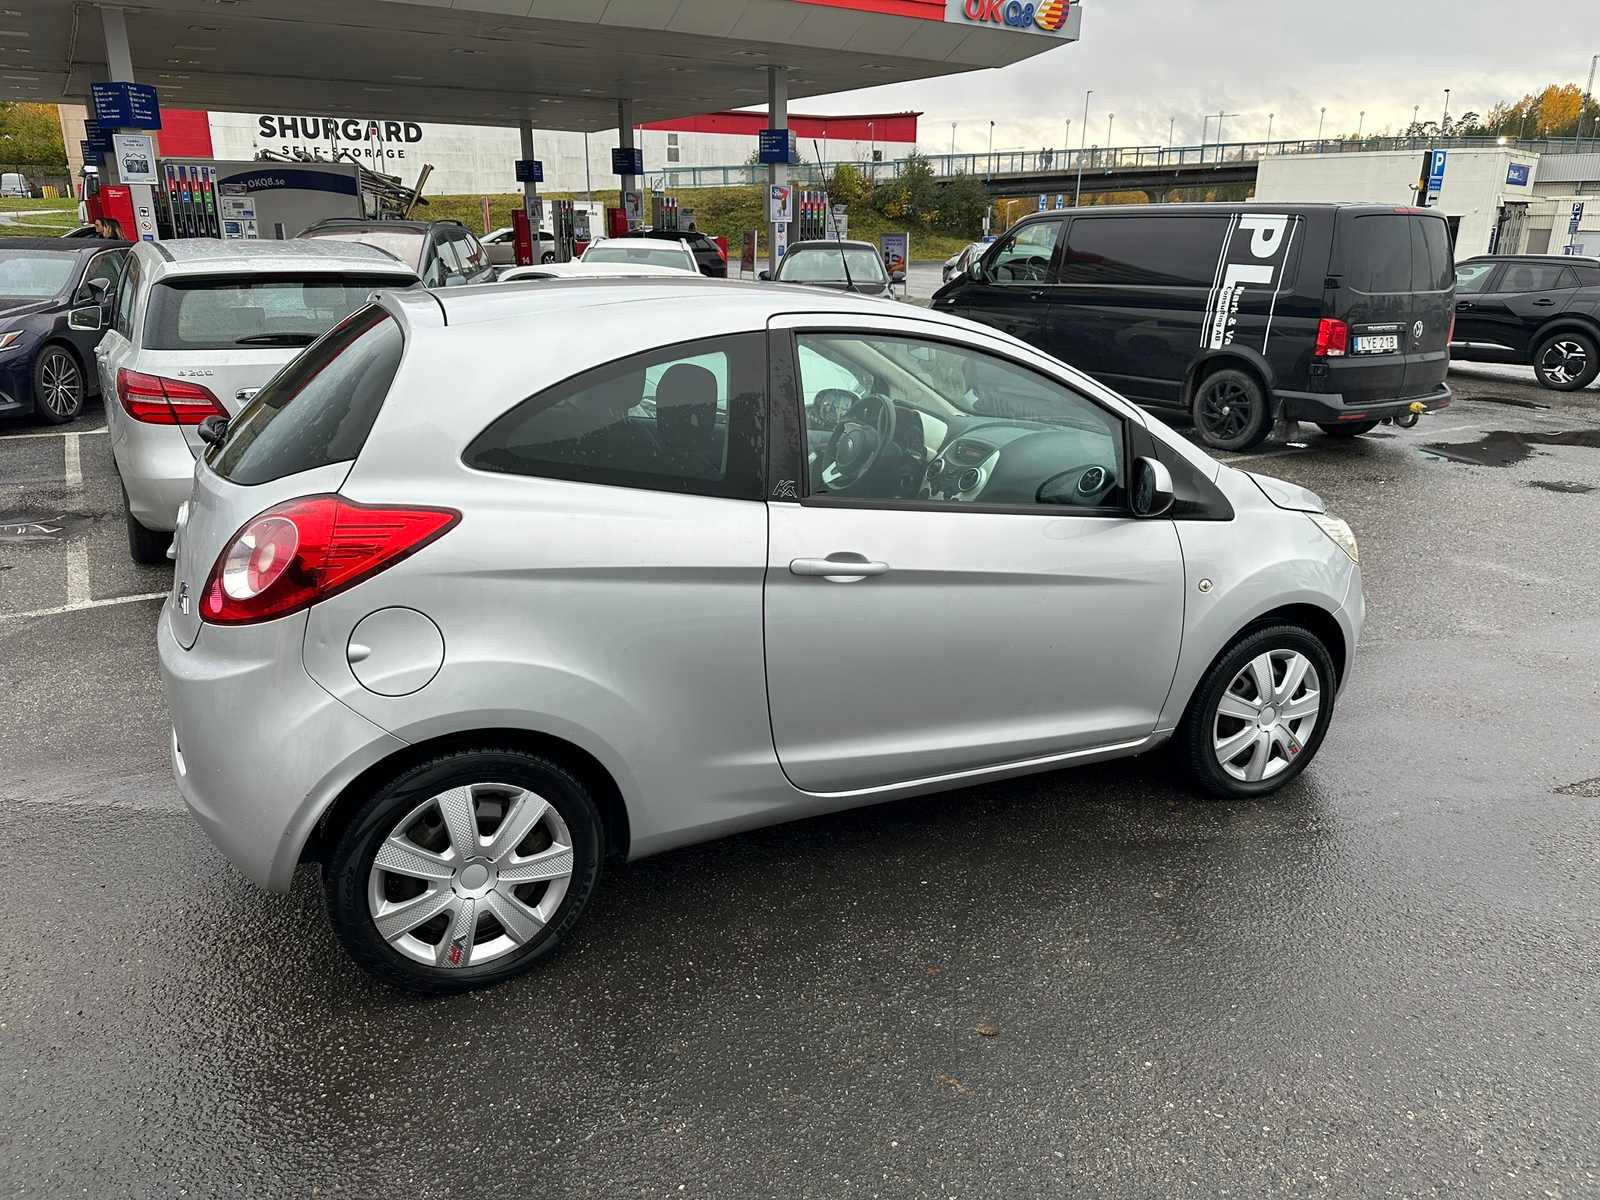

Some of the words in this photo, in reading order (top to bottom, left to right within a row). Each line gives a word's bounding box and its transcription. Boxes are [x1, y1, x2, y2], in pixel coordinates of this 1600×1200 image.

[965, 0, 1034, 27] OKQ8
[258, 115, 423, 143] SHURGARD
[1434, 153, 1444, 175] P
[247, 177, 285, 189] OKQ8.se
[1215, 286, 1233, 328] Consulting
[1229, 286, 1246, 315] Mark
[1227, 317, 1237, 327] &
[1214, 330, 1222, 342] AB
[1223, 330, 1235, 346] Va
[1361, 337, 1378, 350] LYE
[1380, 336, 1395, 348] 21B
[188, 369, 214, 377] 200
